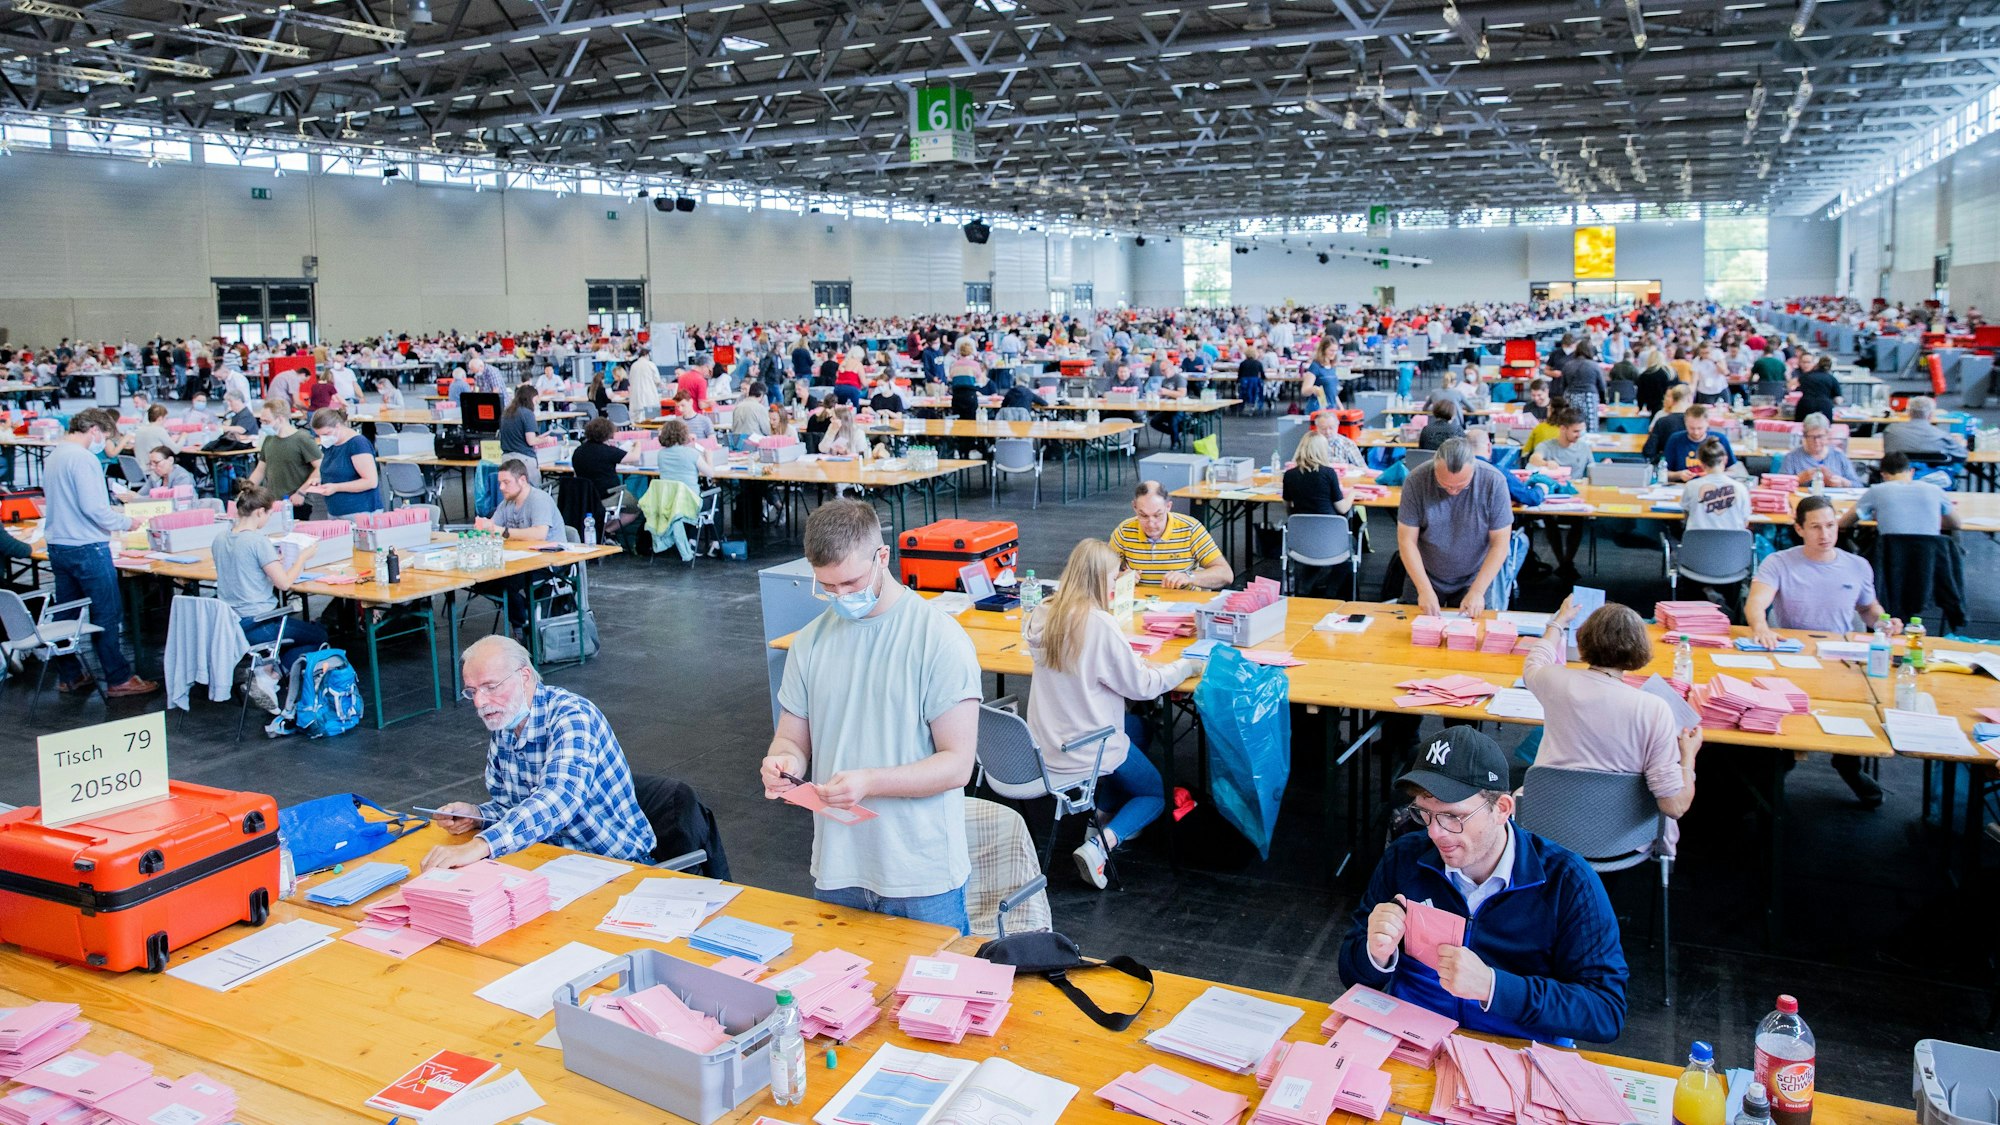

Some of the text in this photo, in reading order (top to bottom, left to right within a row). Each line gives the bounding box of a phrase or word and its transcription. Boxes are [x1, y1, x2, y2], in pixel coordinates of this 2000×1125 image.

[928, 100, 949, 131] 6
[961, 103, 972, 132] 6
[1374, 210, 1385, 225] 6
[54, 729, 152, 768] Tisch 79
[1425, 739, 1452, 766] NY
[70, 769, 143, 803] 20580
